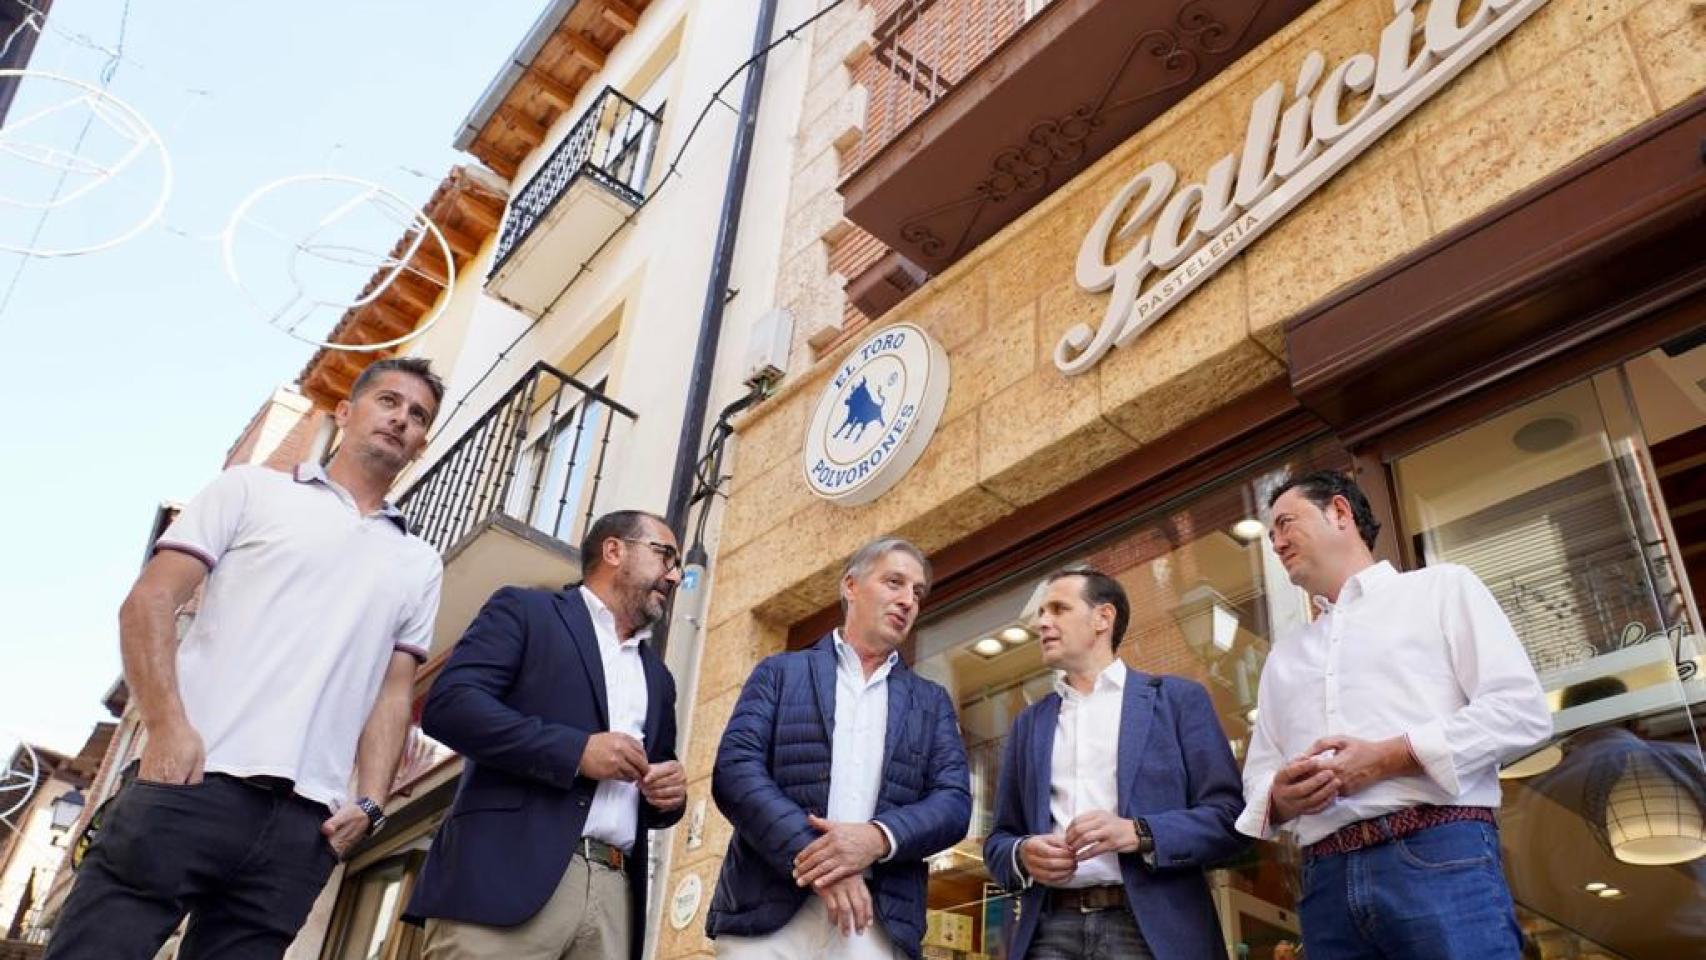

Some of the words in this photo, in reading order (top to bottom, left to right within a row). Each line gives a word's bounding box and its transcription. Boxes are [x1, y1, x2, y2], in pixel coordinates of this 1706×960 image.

[1138, 216, 1259, 318] PASTELERÍA
[834, 365, 856, 388] EL
[861, 333, 905, 361] TORO
[812, 404, 914, 487] POLVORONES
